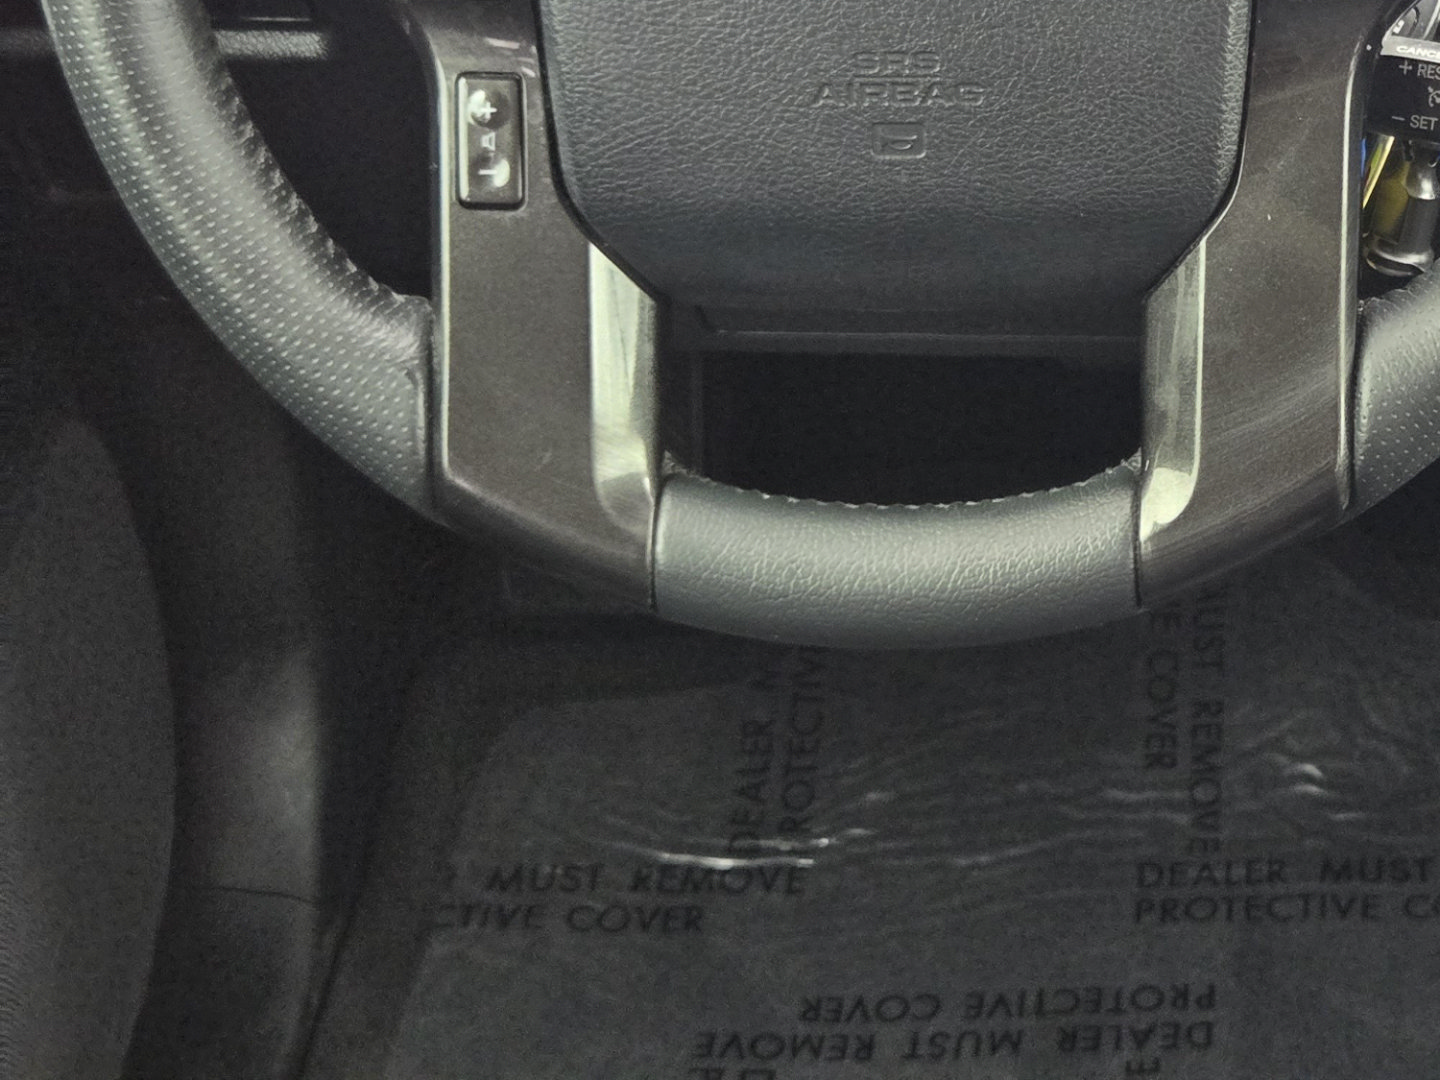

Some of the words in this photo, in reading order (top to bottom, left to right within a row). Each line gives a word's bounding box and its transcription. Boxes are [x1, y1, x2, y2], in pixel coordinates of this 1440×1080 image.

[811, 82, 986, 108] AIRBAG
[1410, 115, 1439, 131] SET
[1187, 699, 1225, 855] REMOVE
[484, 862, 604, 893] MUST
[628, 861, 807, 896] REMOVE
[1134, 858, 1288, 889] DEALER
[1319, 854, 1435, 885] MUST
[566, 903, 706, 934] COVER
[1134, 893, 1382, 923] PROTECTIVE
[799, 992, 942, 1024] COVER
[963, 982, 1217, 1021] PROTECTIVE
[692, 1031, 876, 1063] REMOVE
[901, 1027, 1025, 1061] MUST
[1057, 1019, 1215, 1054] DEALER
